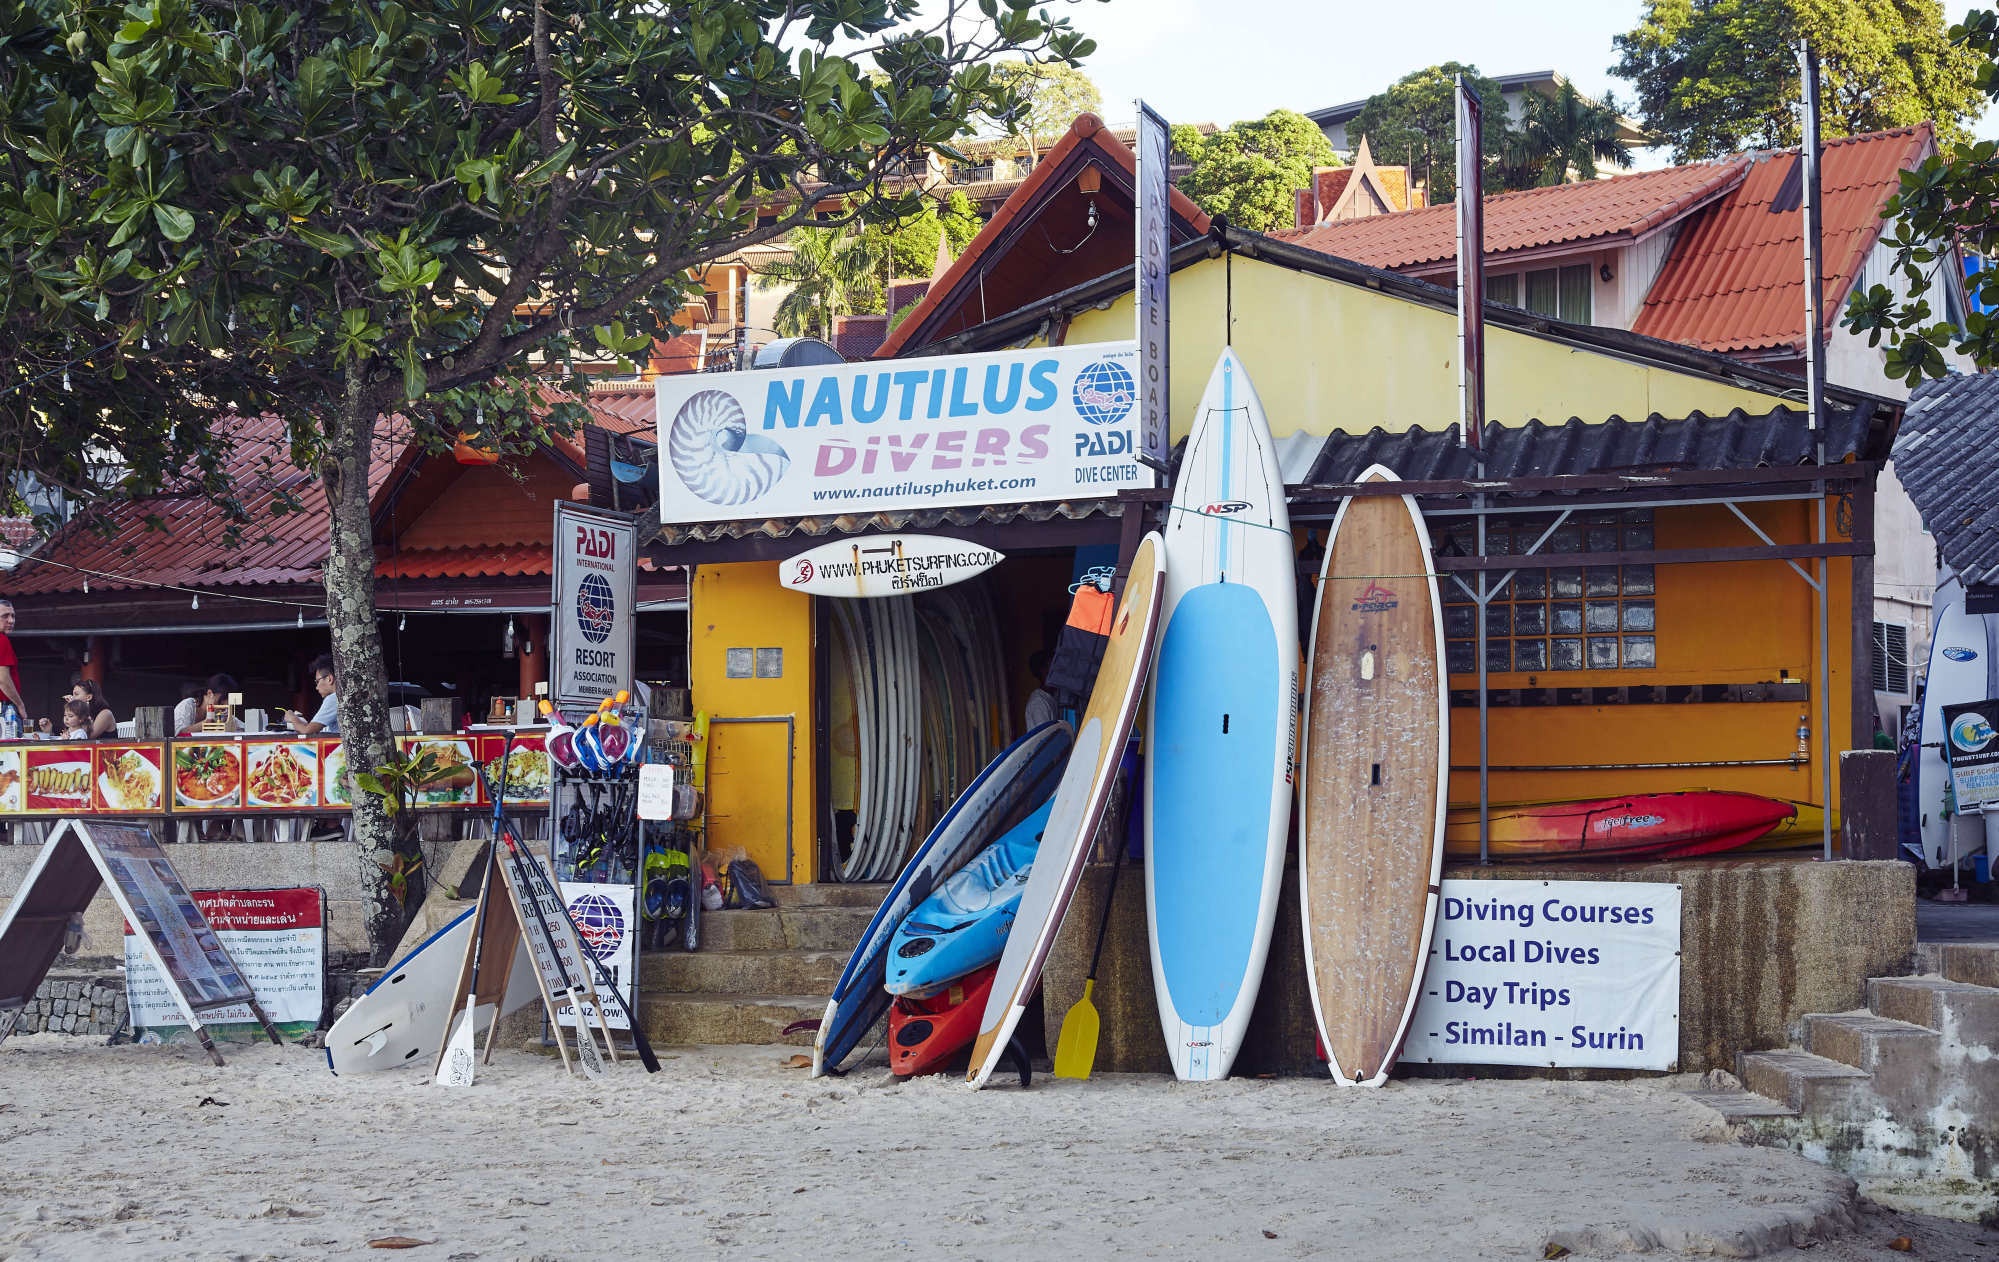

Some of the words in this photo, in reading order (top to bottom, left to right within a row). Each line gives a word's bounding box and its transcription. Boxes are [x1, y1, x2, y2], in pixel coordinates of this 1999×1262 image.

[1148, 194, 1159, 326] PADDLE
[763, 359, 1060, 430] NAUTILUS
[1148, 341, 1159, 450] BOARD
[1075, 430, 1134, 457] PADI
[1075, 466, 1098, 483] DIVE
[1100, 464, 1138, 482] CENTER
[813, 476, 1036, 500] www.nautilusphuket.com
[1205, 503, 1248, 514] NSP
[576, 525, 615, 560] PADI
[576, 558, 615, 573] INTERNATIONAL
[819, 551, 998, 579] WWW.PHUKETSURFING.COM
[576, 648, 616, 669] RESORT
[574, 671, 617, 684] ASSOCIATION
[578, 685, 597, 694] MEMBER
[1952, 751, 1999, 762] PHUKETSURF.CO
[1977, 767, 1999, 775] SCHOO
[198, 894, 275, 907] ทศบาลตำบลกะรน
[521, 899, 562, 918] RETAL
[1444, 897, 1534, 927] Diving
[1542, 899, 1654, 925] Courses
[1445, 939, 1515, 963] Local
[1524, 941, 1600, 965] Dives
[1446, 980, 1498, 1010] Day
[1503, 981, 1571, 1011] Trips
[559, 1006, 593, 1017] LICNZ
[596, 1008, 623, 1018] OW!
[1445, 1021, 1547, 1048] Similan
[1571, 1025, 1645, 1051] Surin
